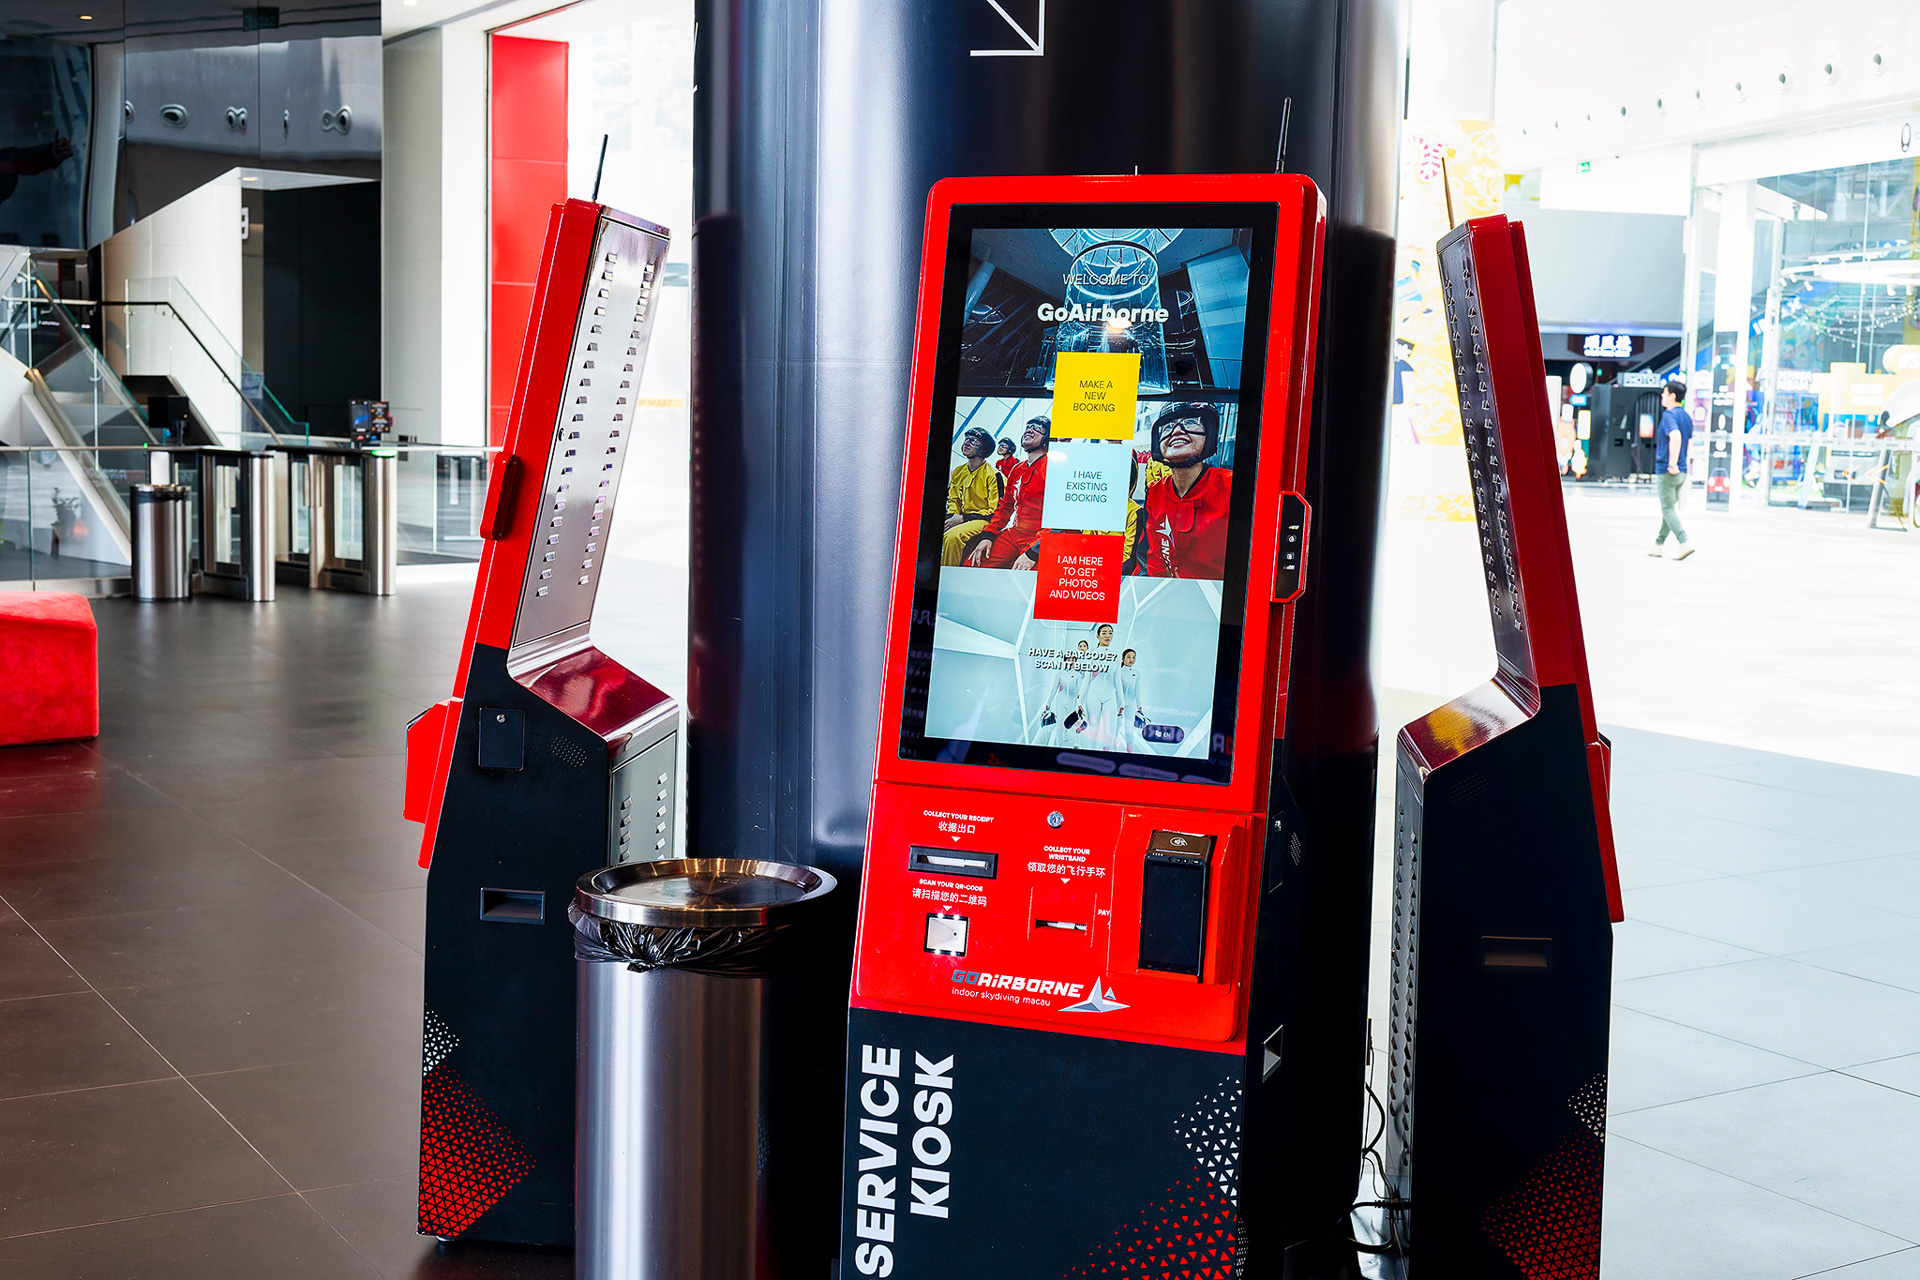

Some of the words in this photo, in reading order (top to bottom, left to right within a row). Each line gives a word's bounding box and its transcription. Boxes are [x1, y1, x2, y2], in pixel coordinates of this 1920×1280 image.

[1062, 273, 1128, 286] WELCOME
[1132, 273, 1150, 286] TO
[1037, 302, 1169, 323] GoAirborne
[1079, 380, 1105, 389] MAKE
[1106, 380, 1114, 389] A
[1084, 391, 1107, 400] NEW
[1072, 402, 1116, 412] BOOKING
[1077, 470, 1102, 480] HAVE
[1066, 481, 1108, 492] EXISTING
[1064, 493, 1107, 503] BOOKING
[1061, 555, 1077, 565] AM
[1078, 556, 1104, 566] HERE
[1062, 566, 1076, 576] TO
[1077, 567, 1097, 577] GET
[1058, 578, 1098, 589] PHOTOS
[1049, 589, 1070, 599] AND
[1071, 590, 1106, 601] VIDEOS
[1028, 647, 1056, 657] HAVE
[1056, 649, 1064, 658] A
[1064, 649, 1118, 662] BARCODE?
[1035, 660, 1062, 670] SCAN
[1063, 661, 1074, 670] IT
[1073, 662, 1110, 673] BELOW
[923, 809, 951, 819] COLLECT
[950, 812, 968, 821] YOUR
[968, 814, 994, 823] RECEIPT
[938, 821, 976, 834] 收据出口
[1043, 845, 1072, 853] COLLECT
[1072, 847, 1091, 855] YOUR
[1048, 853, 1087, 863] WRISTBAND
[1027, 861, 1106, 879] 领取您的飞行手环
[919, 878, 936, 886] SCAN
[937, 880, 954, 889] YOUR
[954, 882, 984, 892] QR-CODE
[912, 887, 987, 907] 请扫描您的二维码
[951, 986, 980, 998] indoor
[980, 990, 1020, 1005] skydiving
[1022, 996, 1051, 1007] macau
[909, 1050, 955, 1219] KIOSK
[854, 1044, 901, 1279] SERVICE
